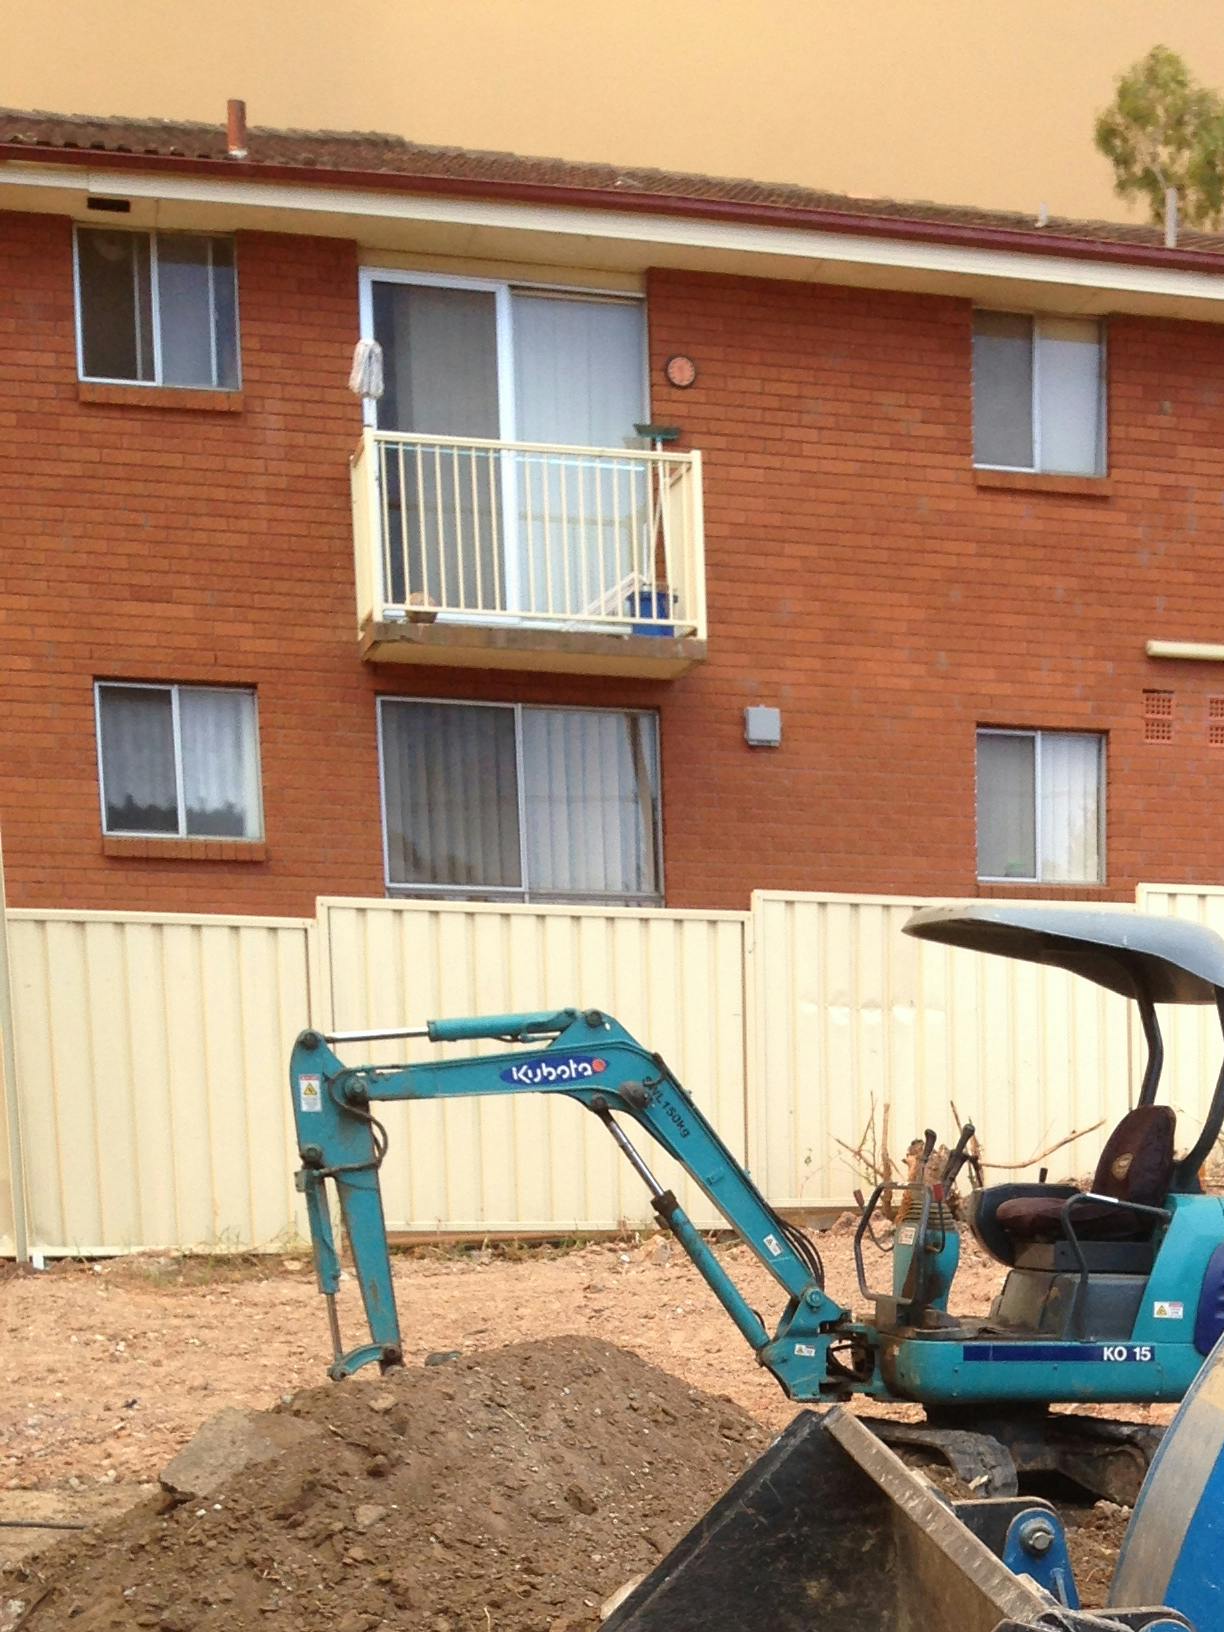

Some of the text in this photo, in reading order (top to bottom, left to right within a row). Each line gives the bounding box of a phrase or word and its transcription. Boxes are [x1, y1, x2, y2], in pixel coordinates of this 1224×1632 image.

[512, 1059, 592, 1083] Kubota
[1103, 1345, 1152, 1361] KO 15
